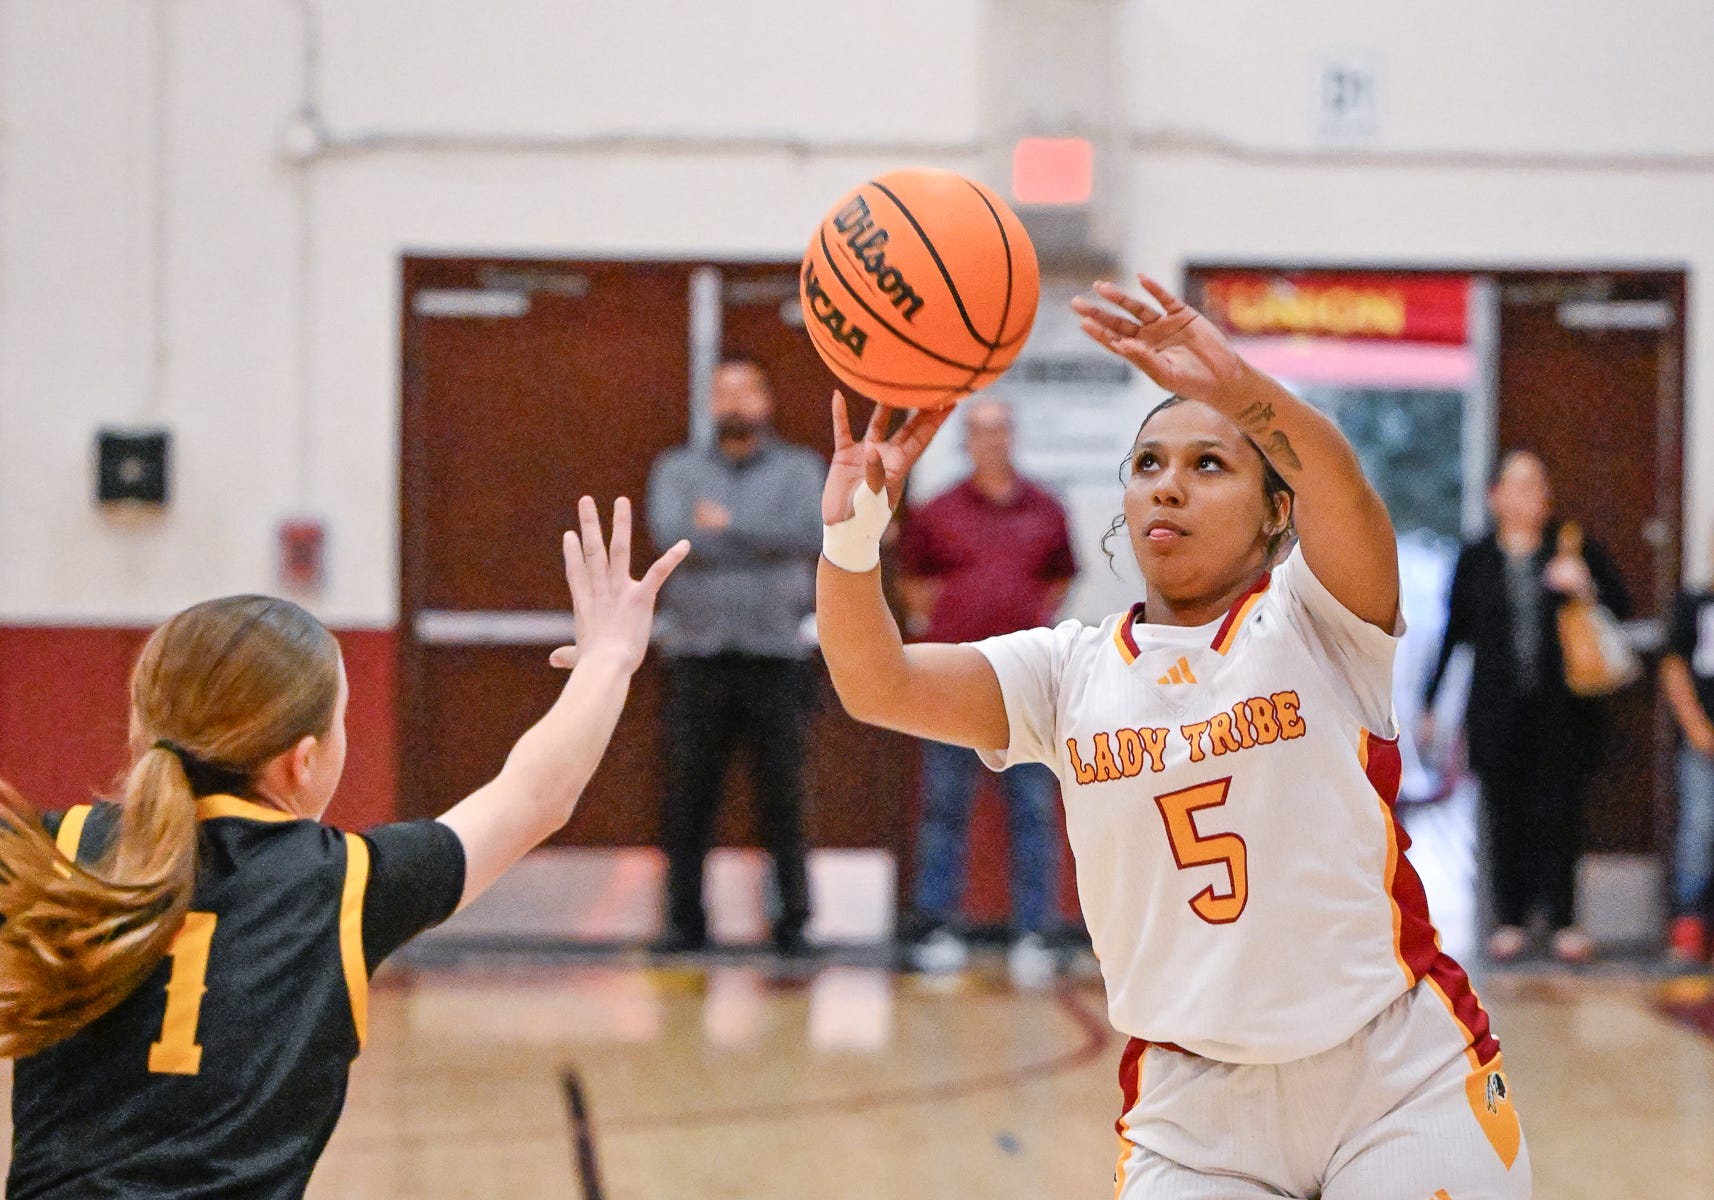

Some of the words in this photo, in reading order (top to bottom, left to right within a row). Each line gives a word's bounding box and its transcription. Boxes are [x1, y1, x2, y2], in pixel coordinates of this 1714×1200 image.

[833, 194, 925, 322] Wilson
[1066, 726, 1171, 785] LADY
[1180, 690, 1307, 763] TRIBE
[1153, 775, 1249, 925] 5
[147, 911, 219, 1076] 1
